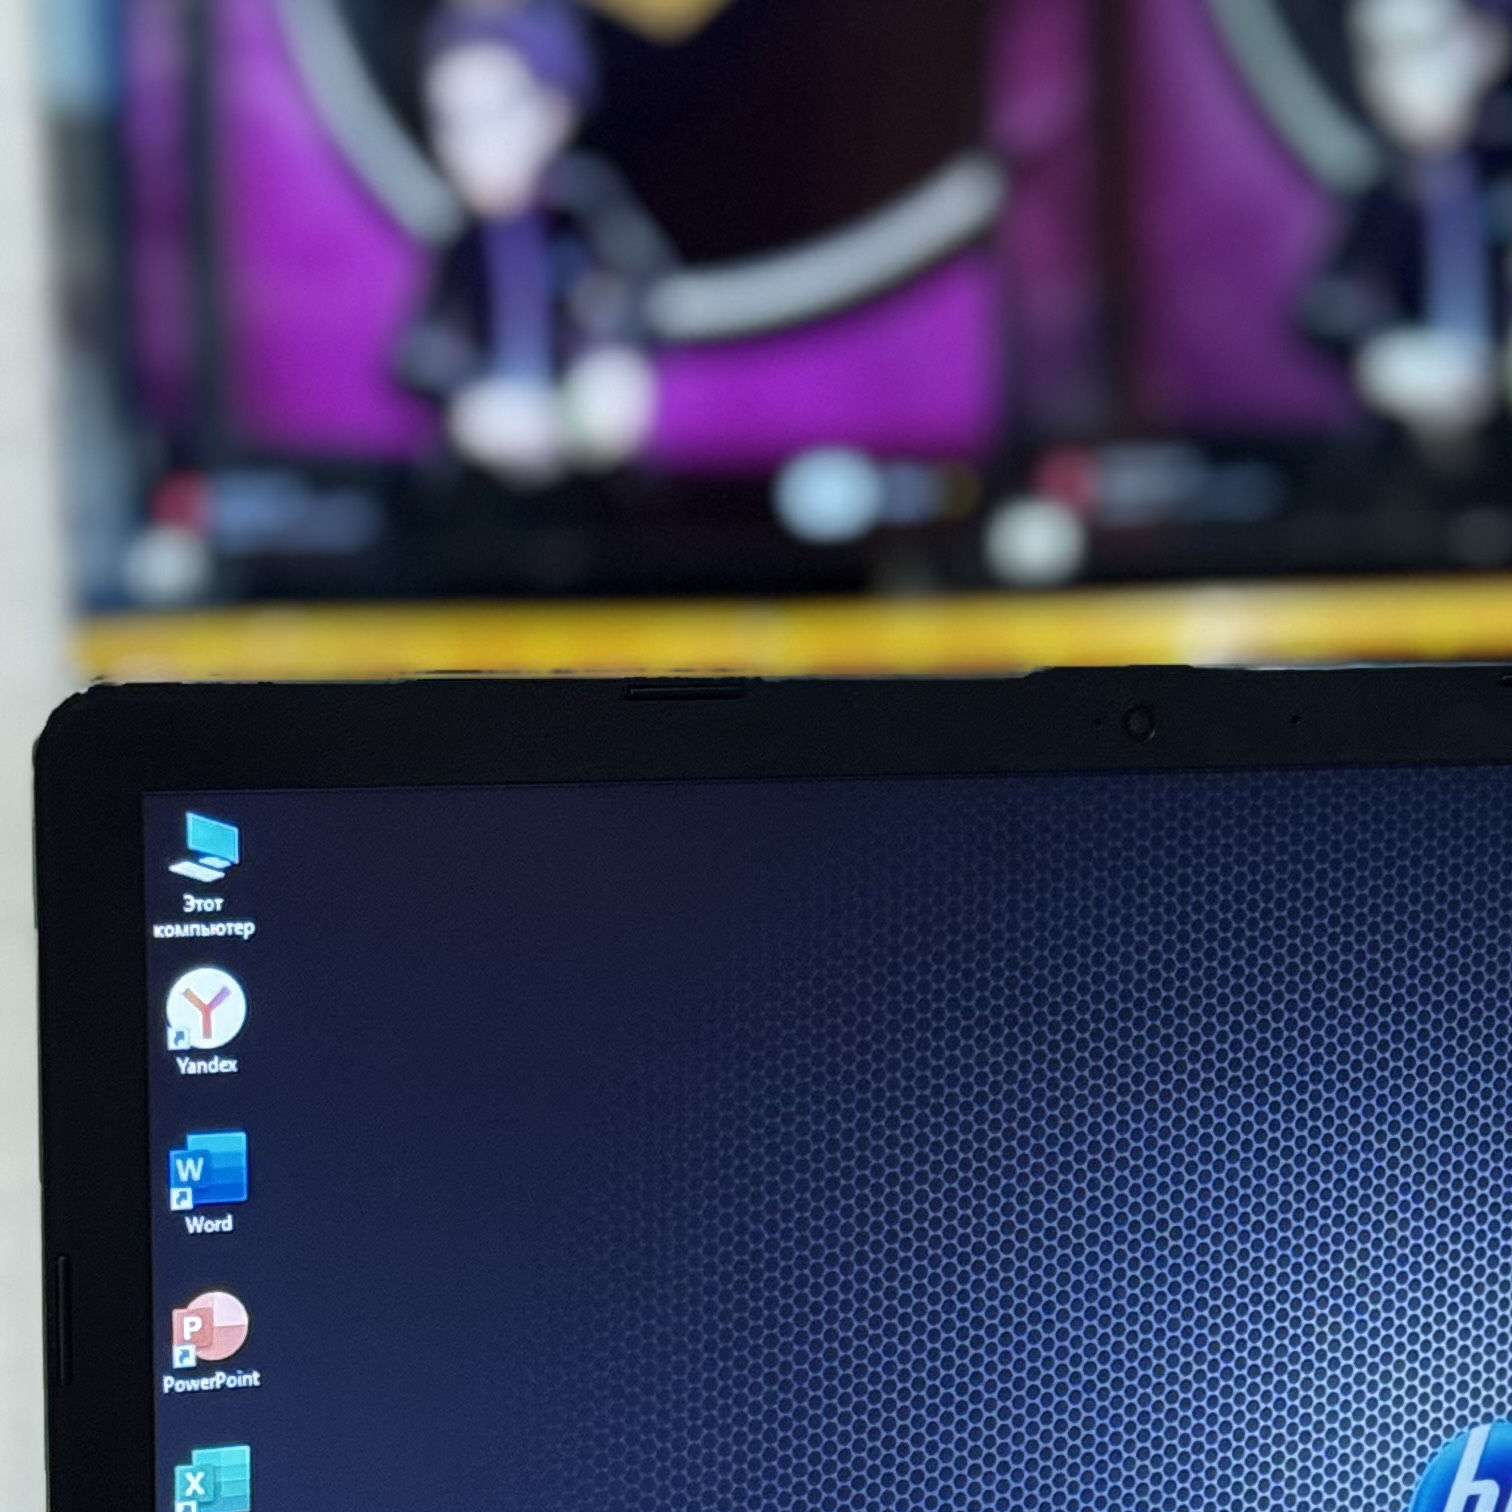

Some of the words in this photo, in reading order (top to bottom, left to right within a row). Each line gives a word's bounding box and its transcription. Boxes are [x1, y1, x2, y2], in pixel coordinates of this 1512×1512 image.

[182, 894, 225, 914] Этот
[152, 920, 257, 940] компьютер
[175, 1056, 239, 1076] Yandex
[175, 1157, 204, 1182] W
[185, 1213, 234, 1235] Word
[182, 1315, 203, 1341] P
[162, 1369, 262, 1394] PowerPoint
[184, 1472, 206, 1496] X
